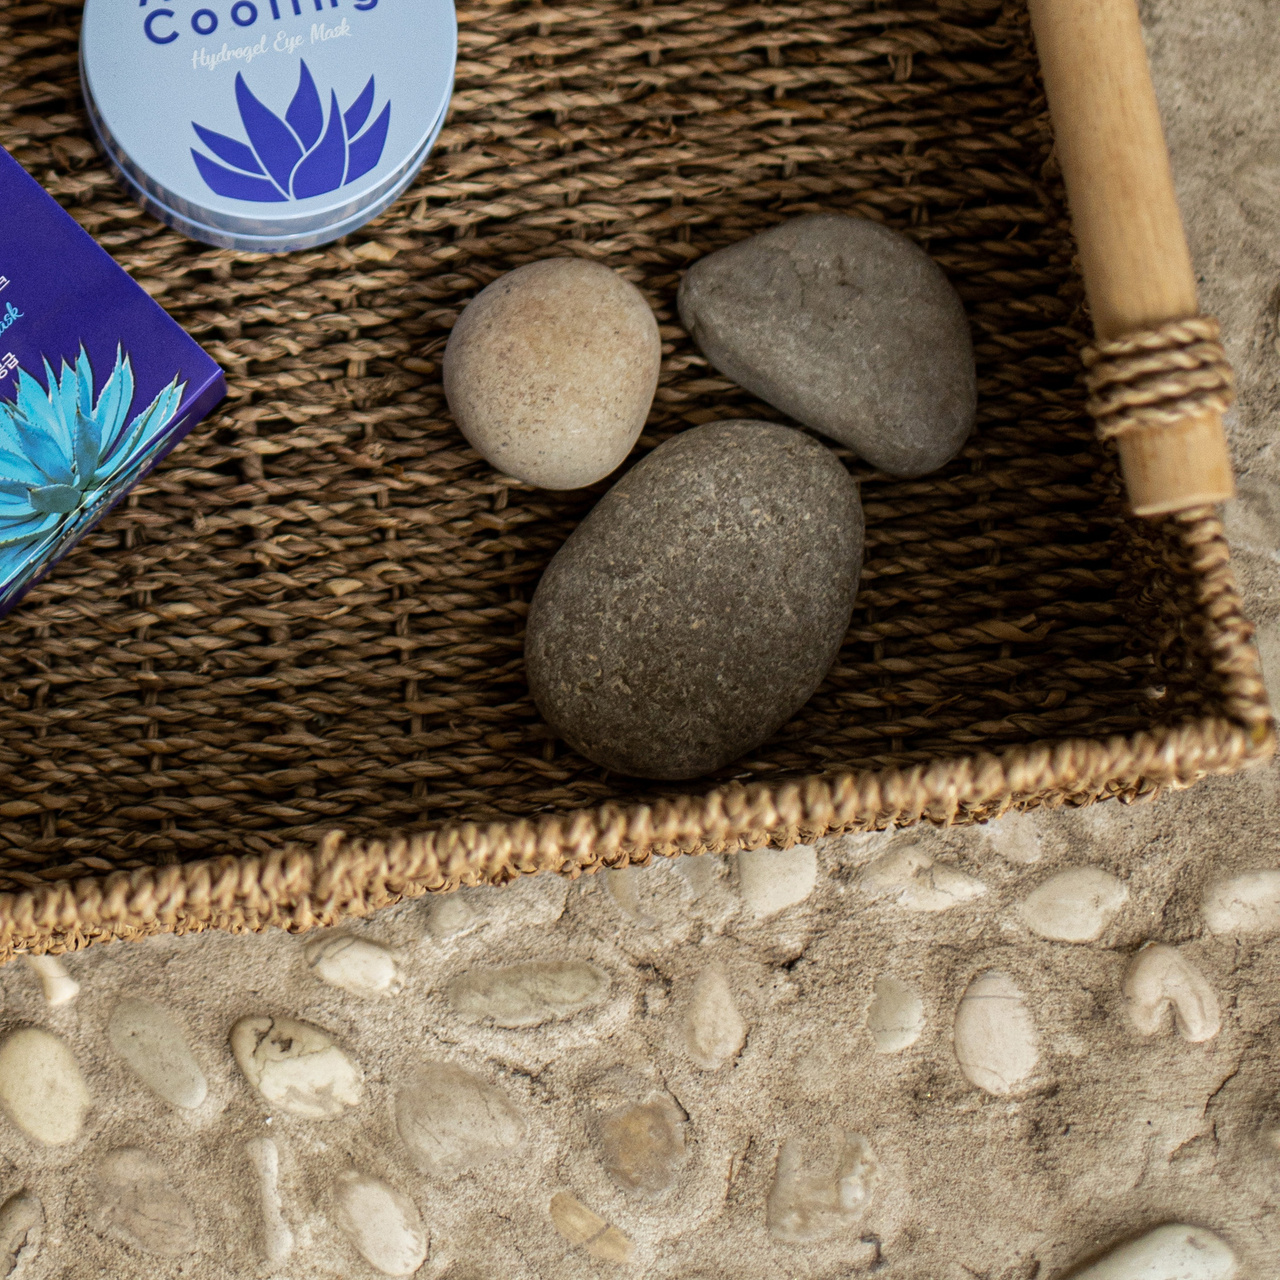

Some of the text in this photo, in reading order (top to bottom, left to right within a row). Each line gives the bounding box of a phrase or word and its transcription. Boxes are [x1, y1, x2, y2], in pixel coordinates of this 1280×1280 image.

[191, 17, 352, 70] Hydrogel Eye Mask
